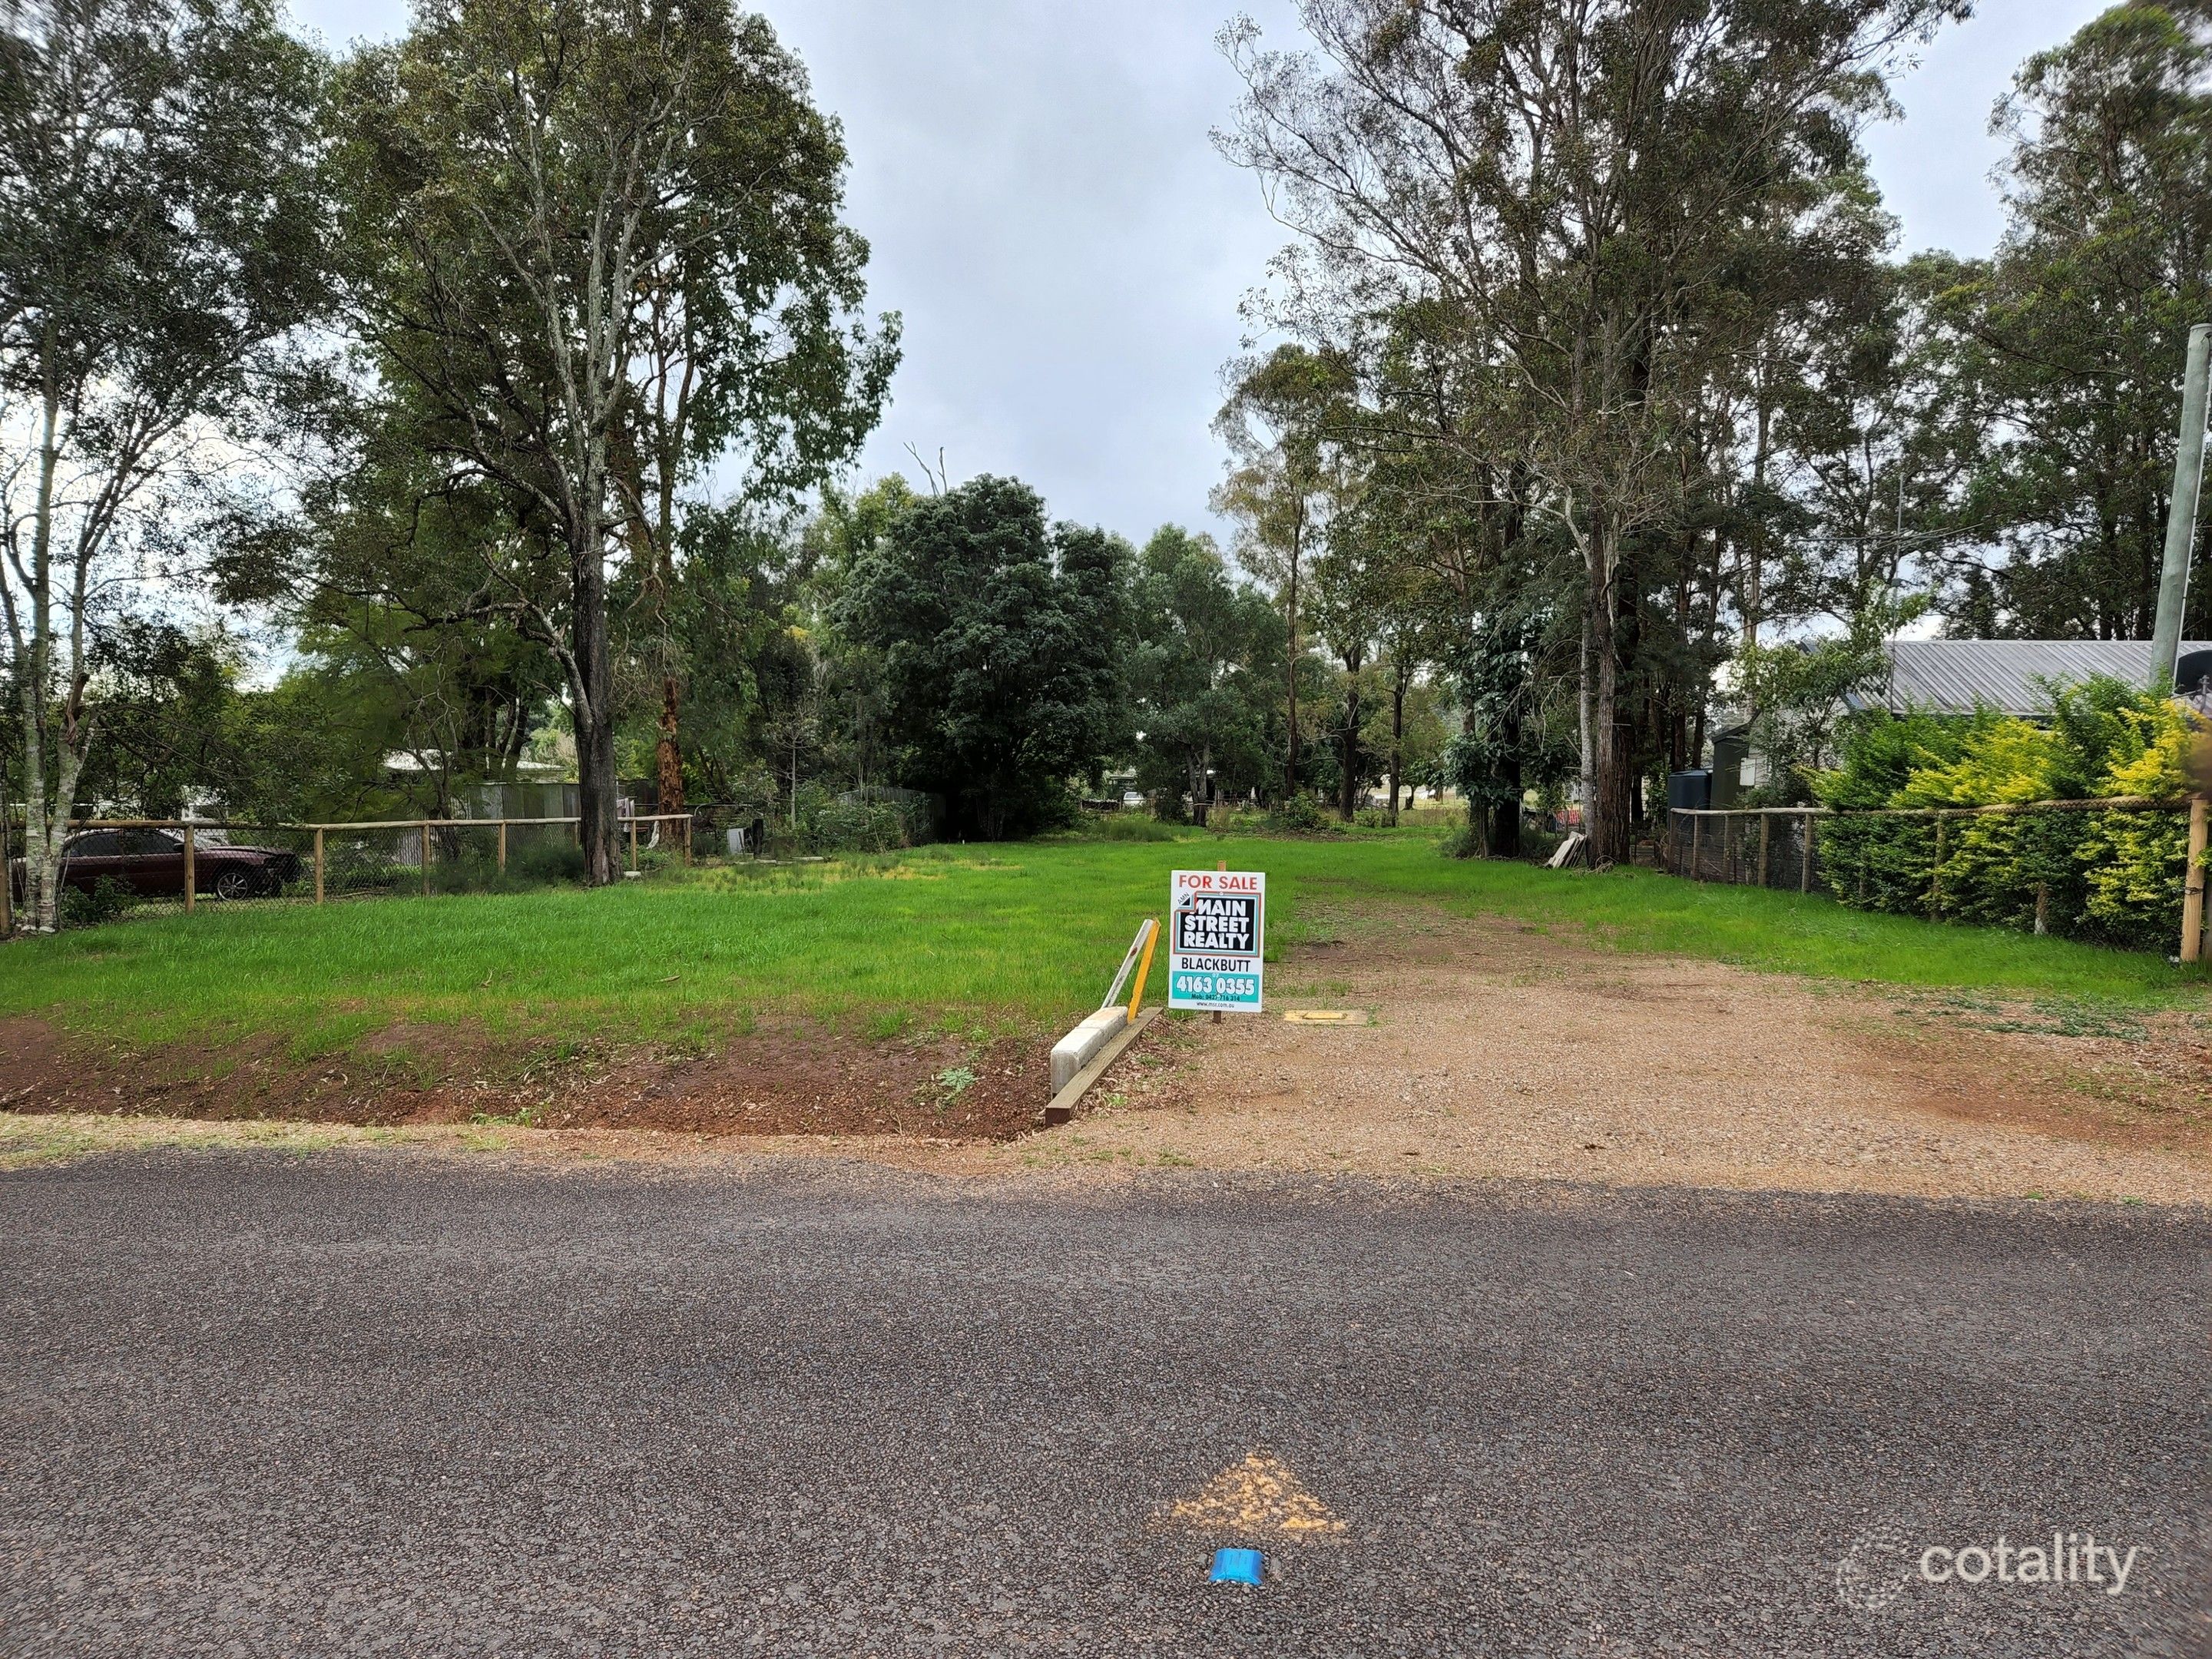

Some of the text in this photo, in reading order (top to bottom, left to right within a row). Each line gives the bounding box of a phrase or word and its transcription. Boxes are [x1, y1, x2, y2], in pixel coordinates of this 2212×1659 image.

[1179, 875, 1257, 890] FOR SALE
[1177, 892, 1190, 905] AMN
[1190, 899, 1246, 916] MAIN
[1184, 916, 1249, 932] STREET
[1184, 932, 1249, 949] REALTY
[1181, 957, 1251, 972] BLACKBUTT
[1176, 975, 1255, 995] 4163 0355
